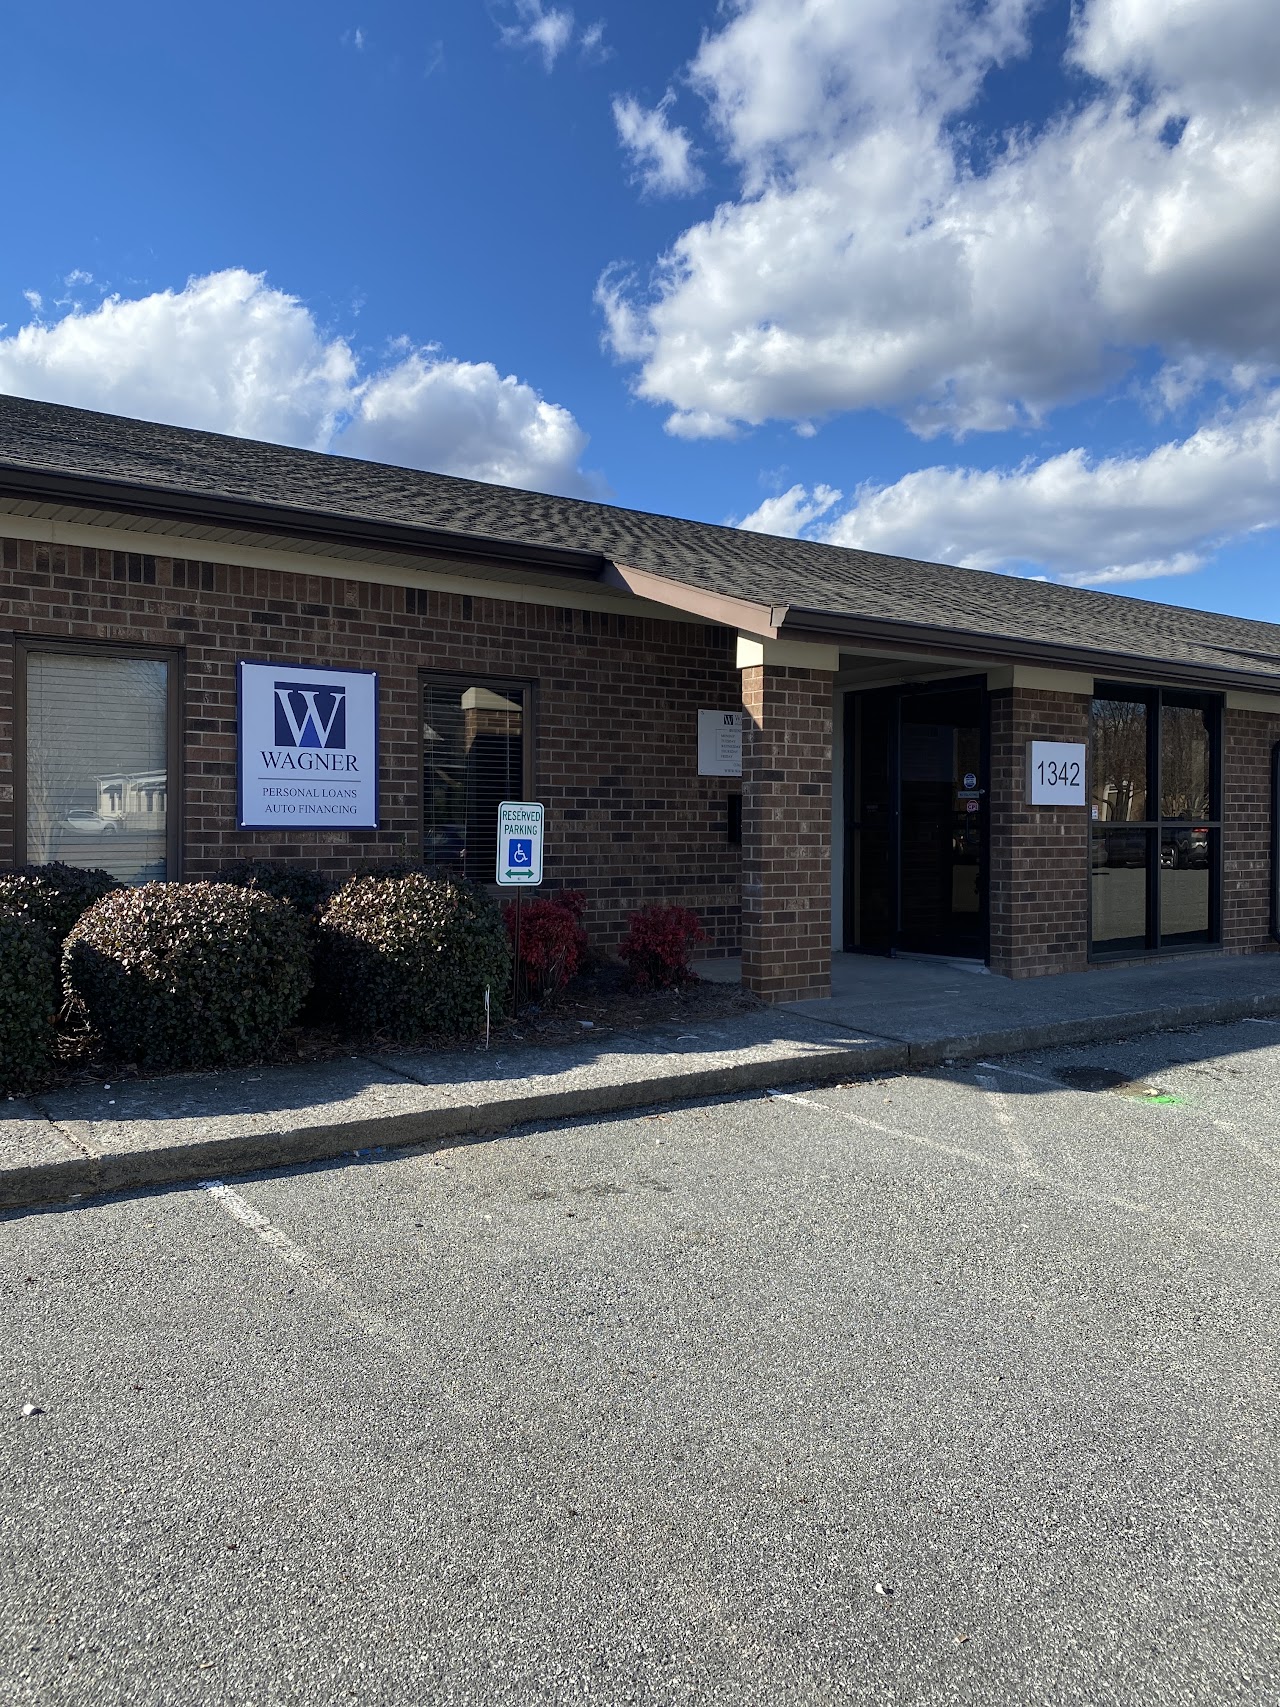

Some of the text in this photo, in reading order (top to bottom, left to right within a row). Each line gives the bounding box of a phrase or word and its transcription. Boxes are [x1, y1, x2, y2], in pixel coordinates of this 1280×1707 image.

[274, 689, 346, 749] W
[260, 750, 360, 772] WAGNER
[1037, 760, 1080, 787] 1342
[262, 787, 357, 799] PERSONAL LOANS
[264, 804, 357, 815] AUTO FINANCING
[502, 810, 541, 822] RESERVED
[504, 824, 538, 836] PARKING
